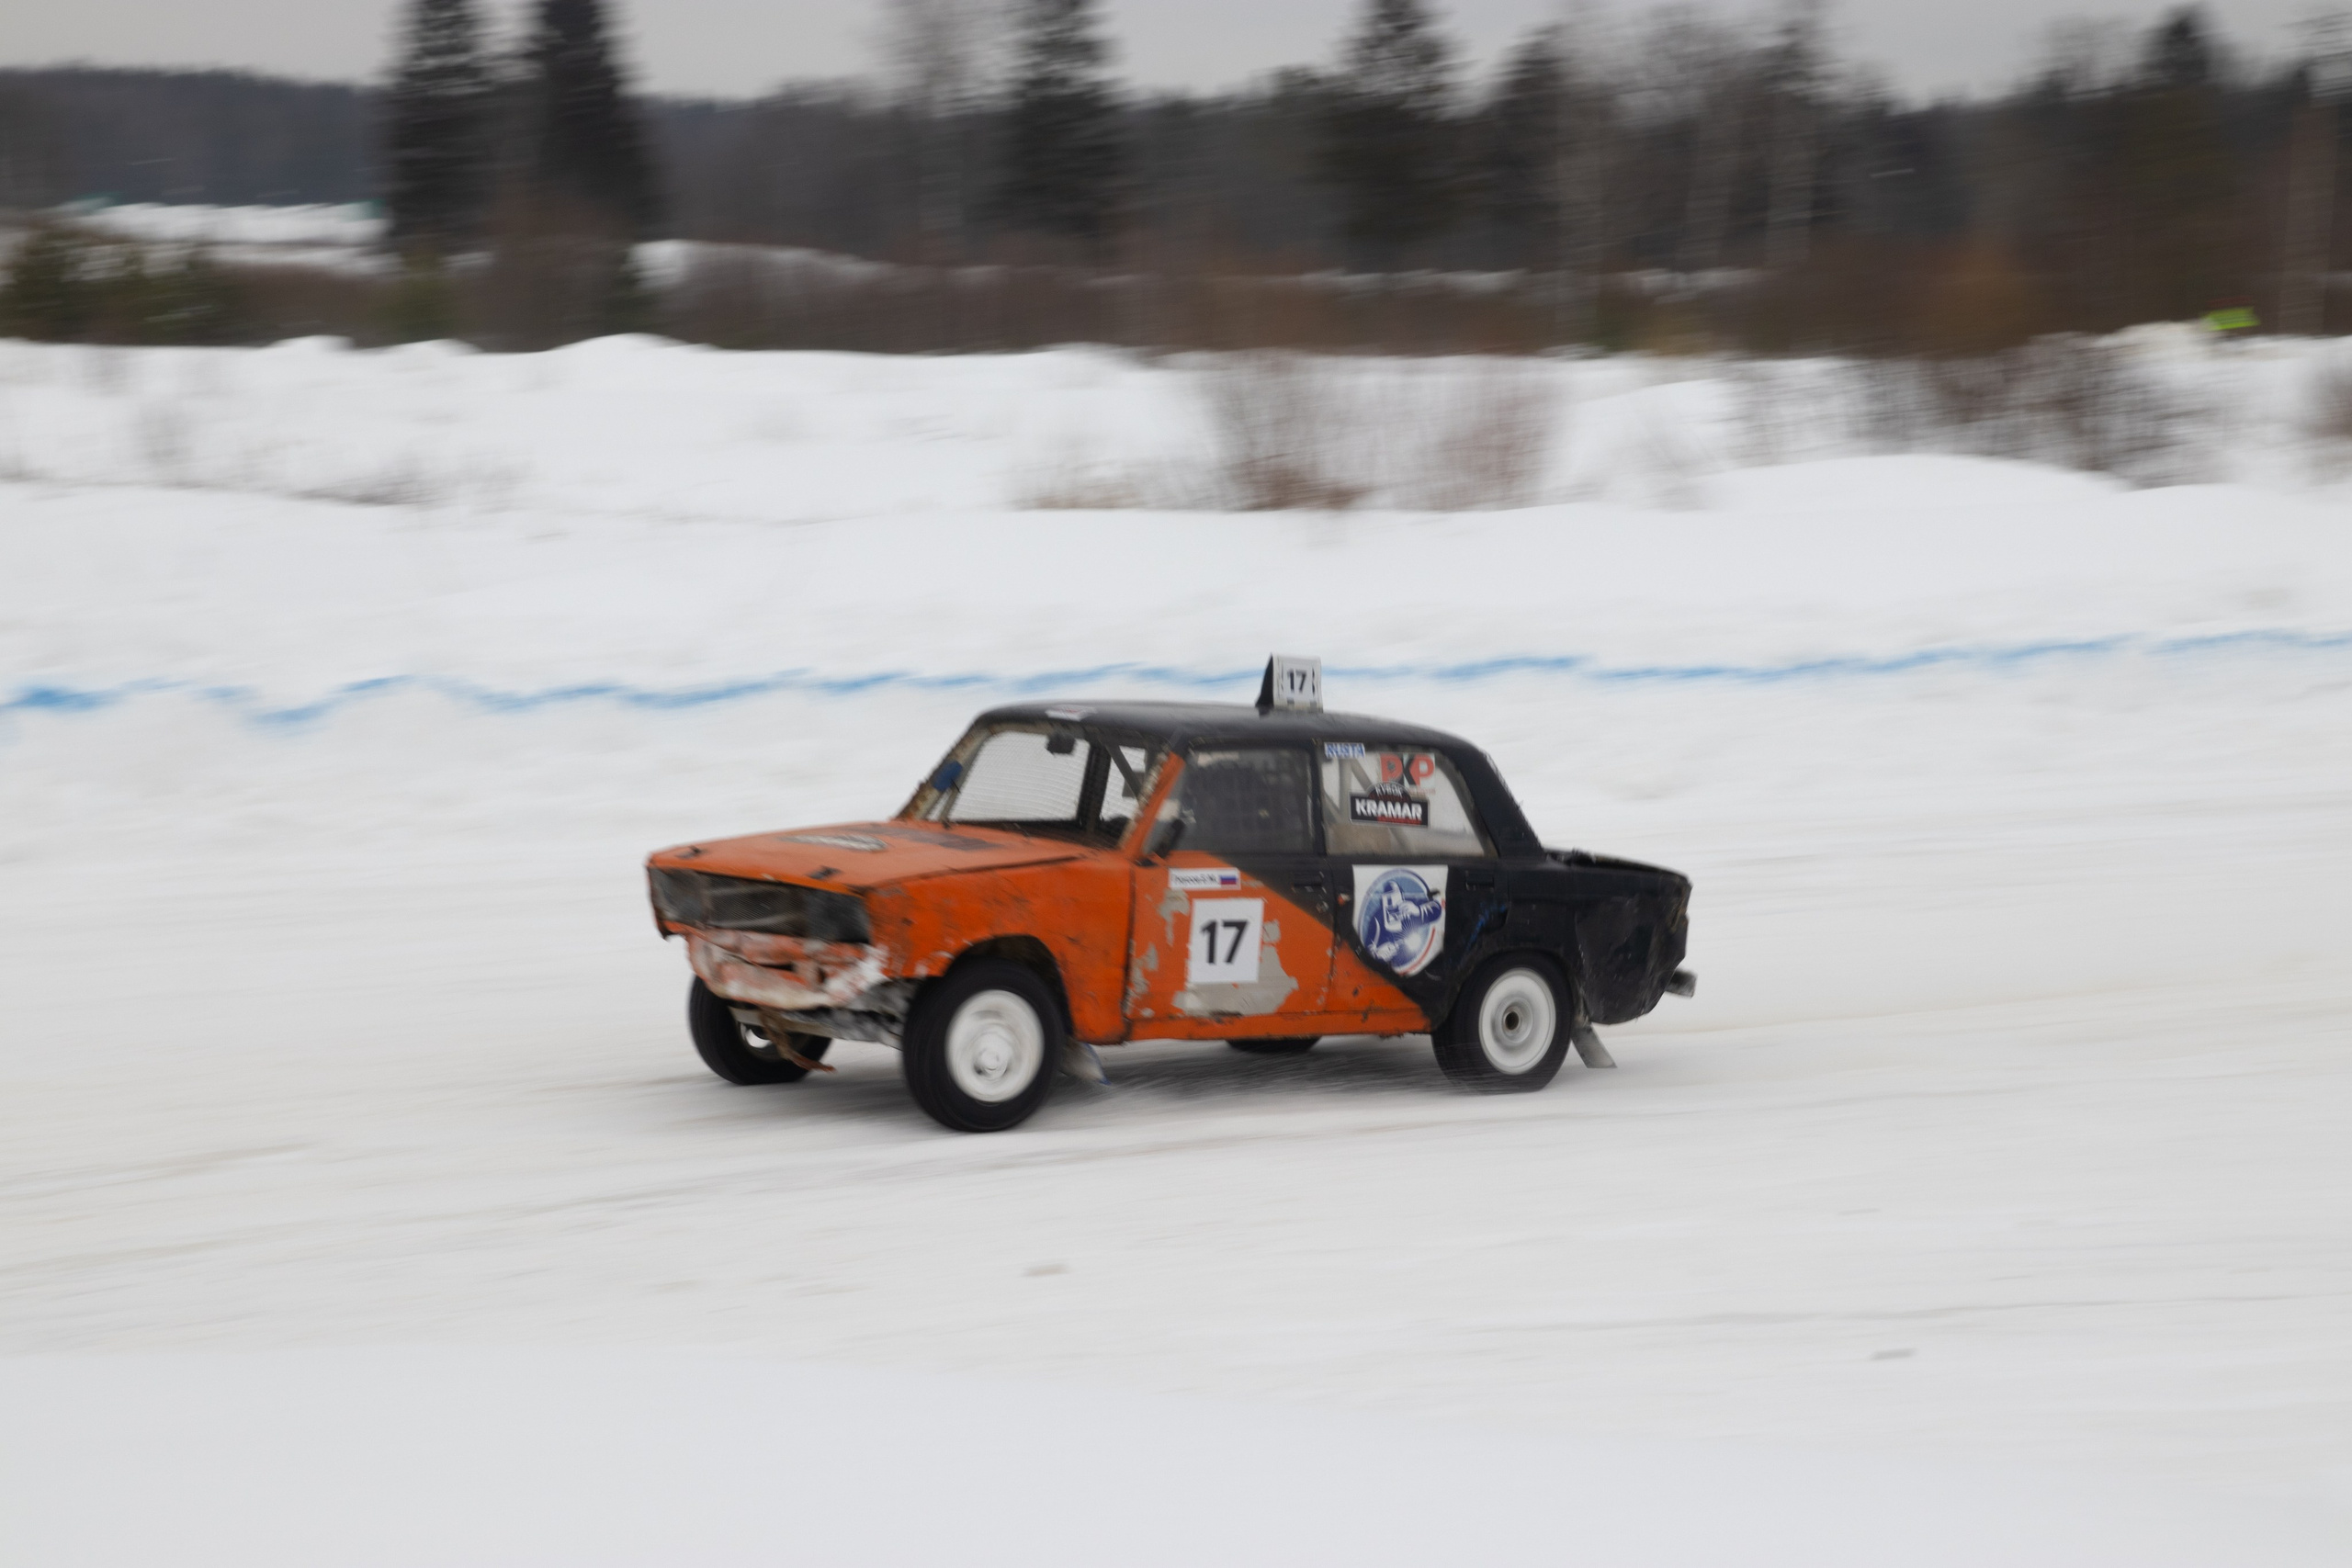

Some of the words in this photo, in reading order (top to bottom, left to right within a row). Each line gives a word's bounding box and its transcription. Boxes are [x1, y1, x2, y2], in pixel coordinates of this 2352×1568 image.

[1286, 668, 1306, 693] 17
[1355, 798, 1422, 820] KRAMAR
[1200, 919, 1250, 965] 17
